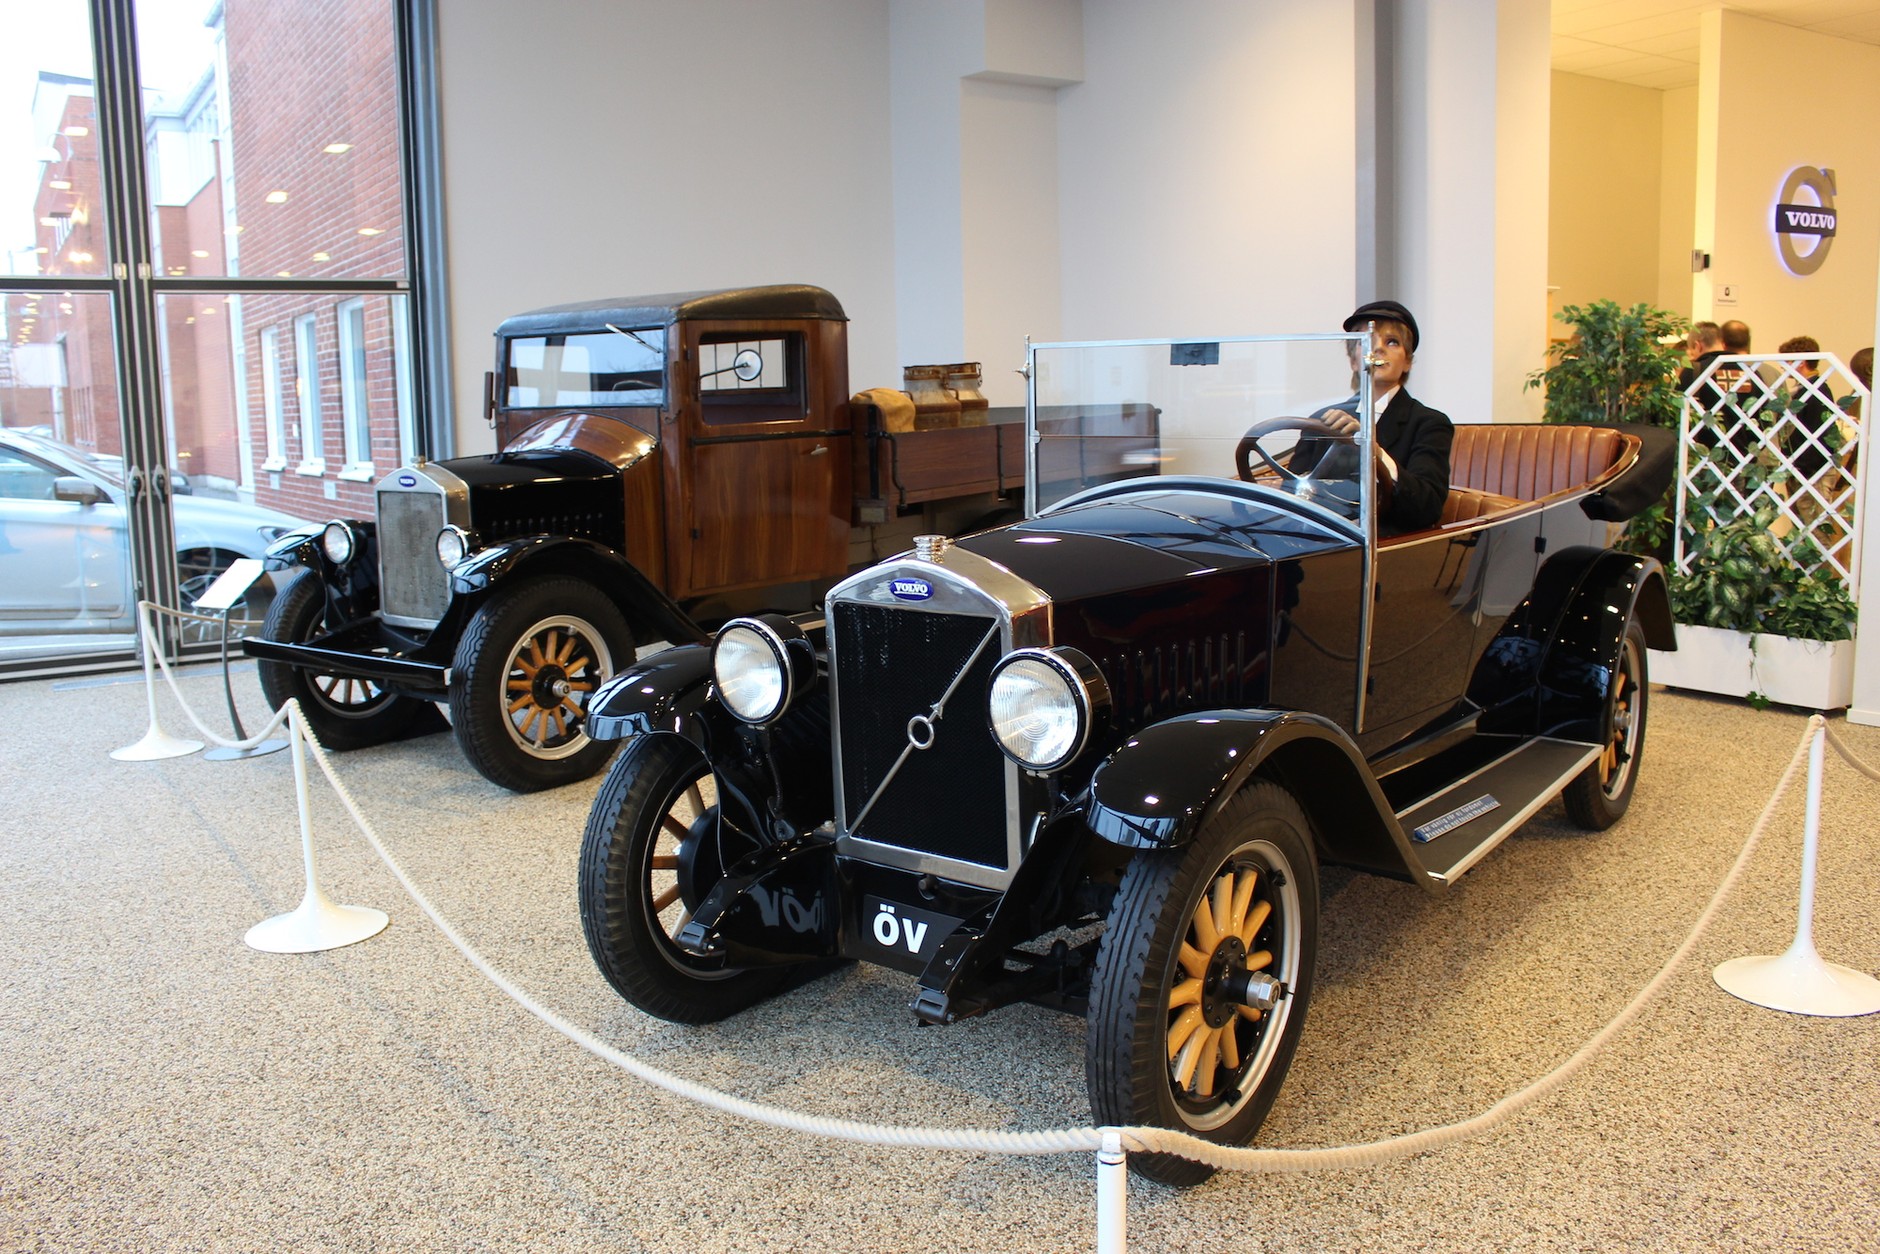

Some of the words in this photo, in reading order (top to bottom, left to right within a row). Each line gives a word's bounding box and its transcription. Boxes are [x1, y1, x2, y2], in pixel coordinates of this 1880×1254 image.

[1785, 211, 1835, 229] VOLVO
[894, 582, 928, 594] VOLVO
[873, 903, 928, 954] ÖV
